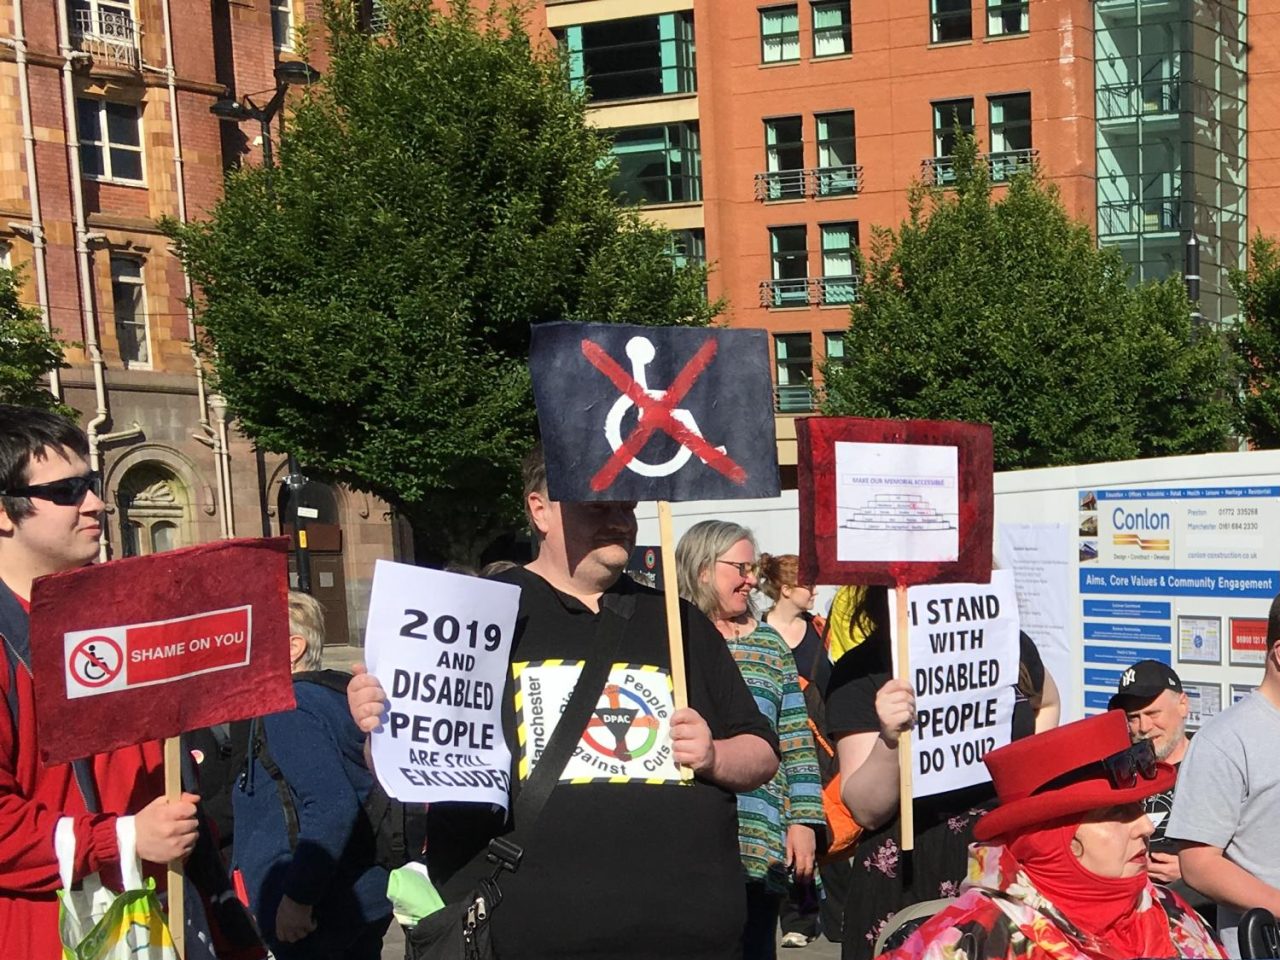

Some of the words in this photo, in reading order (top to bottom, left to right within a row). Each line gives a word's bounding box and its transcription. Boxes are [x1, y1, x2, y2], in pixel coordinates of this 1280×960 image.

[1113, 507, 1170, 530] Conlon
[1086, 574, 1107, 587] Aims,
[1110, 575, 1129, 586] Core
[1131, 576, 1157, 587] Values
[1160, 576, 1165, 586] &
[1168, 576, 1215, 590] Community
[1218, 577, 1272, 590] Engagement
[911, 601, 918, 626] I
[927, 594, 1000, 625] STAND
[400, 608, 502, 651] 2019
[929, 629, 984, 654] WITH
[131, 642, 185, 663] SHAME
[189, 637, 211, 652] ON
[214, 631, 244, 647] YOU
[436, 651, 475, 672] AND
[392, 668, 493, 710] DISABLED
[916, 658, 1000, 697] DISABLED
[624, 674, 668, 719] People
[390, 712, 494, 750] PEOPLE
[603, 714, 630, 724] DPAC
[917, 698, 998, 740] PEOPLE
[410, 748, 441, 767] ARE
[445, 753, 492, 768] STILL
[572, 745, 626, 775] gainst
[643, 744, 670, 772] Cuts
[920, 748, 944, 774] DO
[951, 736, 996, 768] YOU?
[399, 767, 510, 792] EXCLUDED
